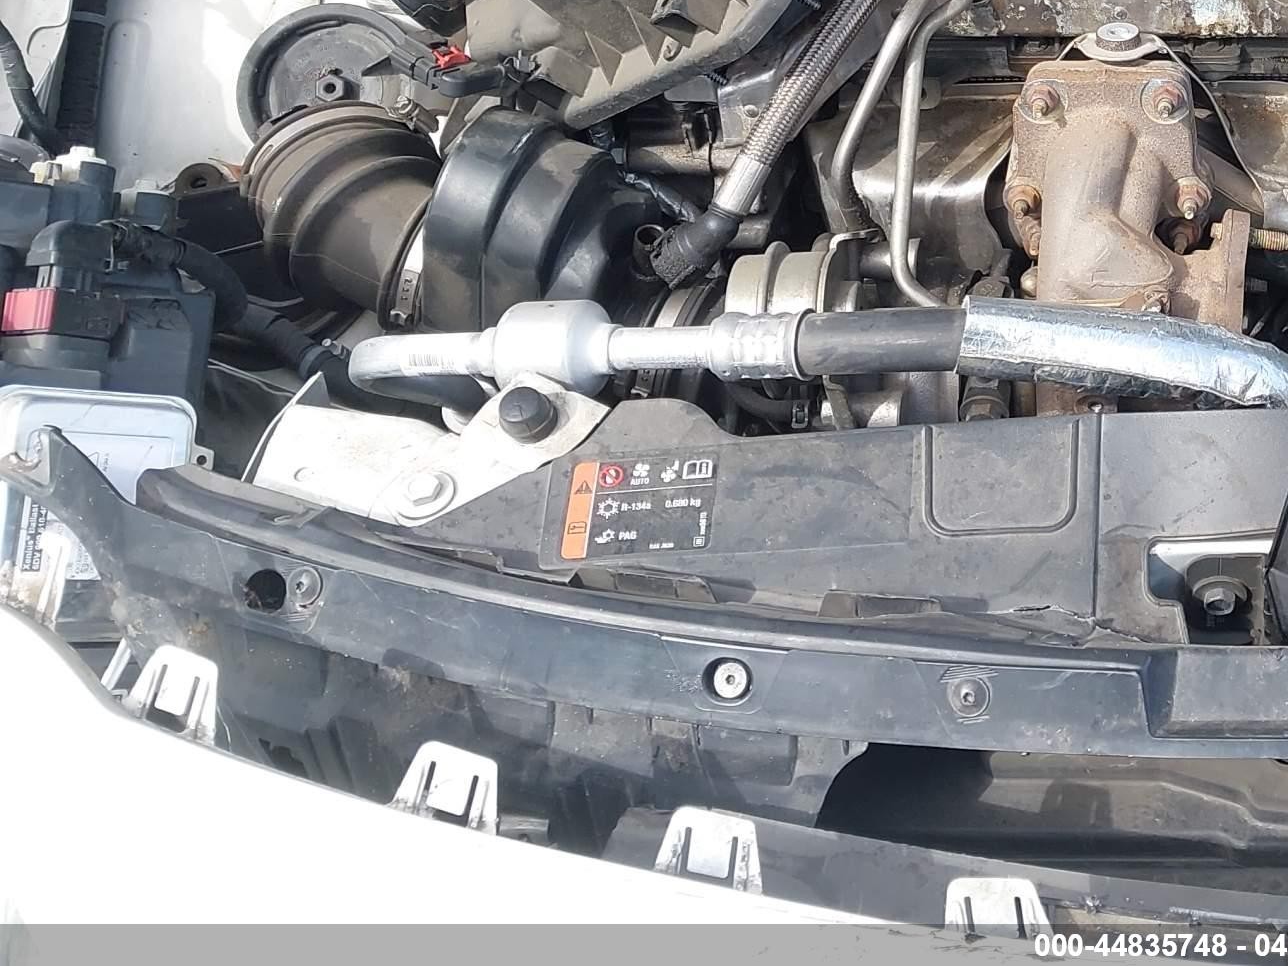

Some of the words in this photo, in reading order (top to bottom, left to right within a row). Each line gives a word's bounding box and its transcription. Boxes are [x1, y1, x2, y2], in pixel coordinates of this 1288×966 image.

[630, 476, 650, 486] AUTO
[620, 501, 652, 512] R-134a
[618, 530, 637, 541] PAG
